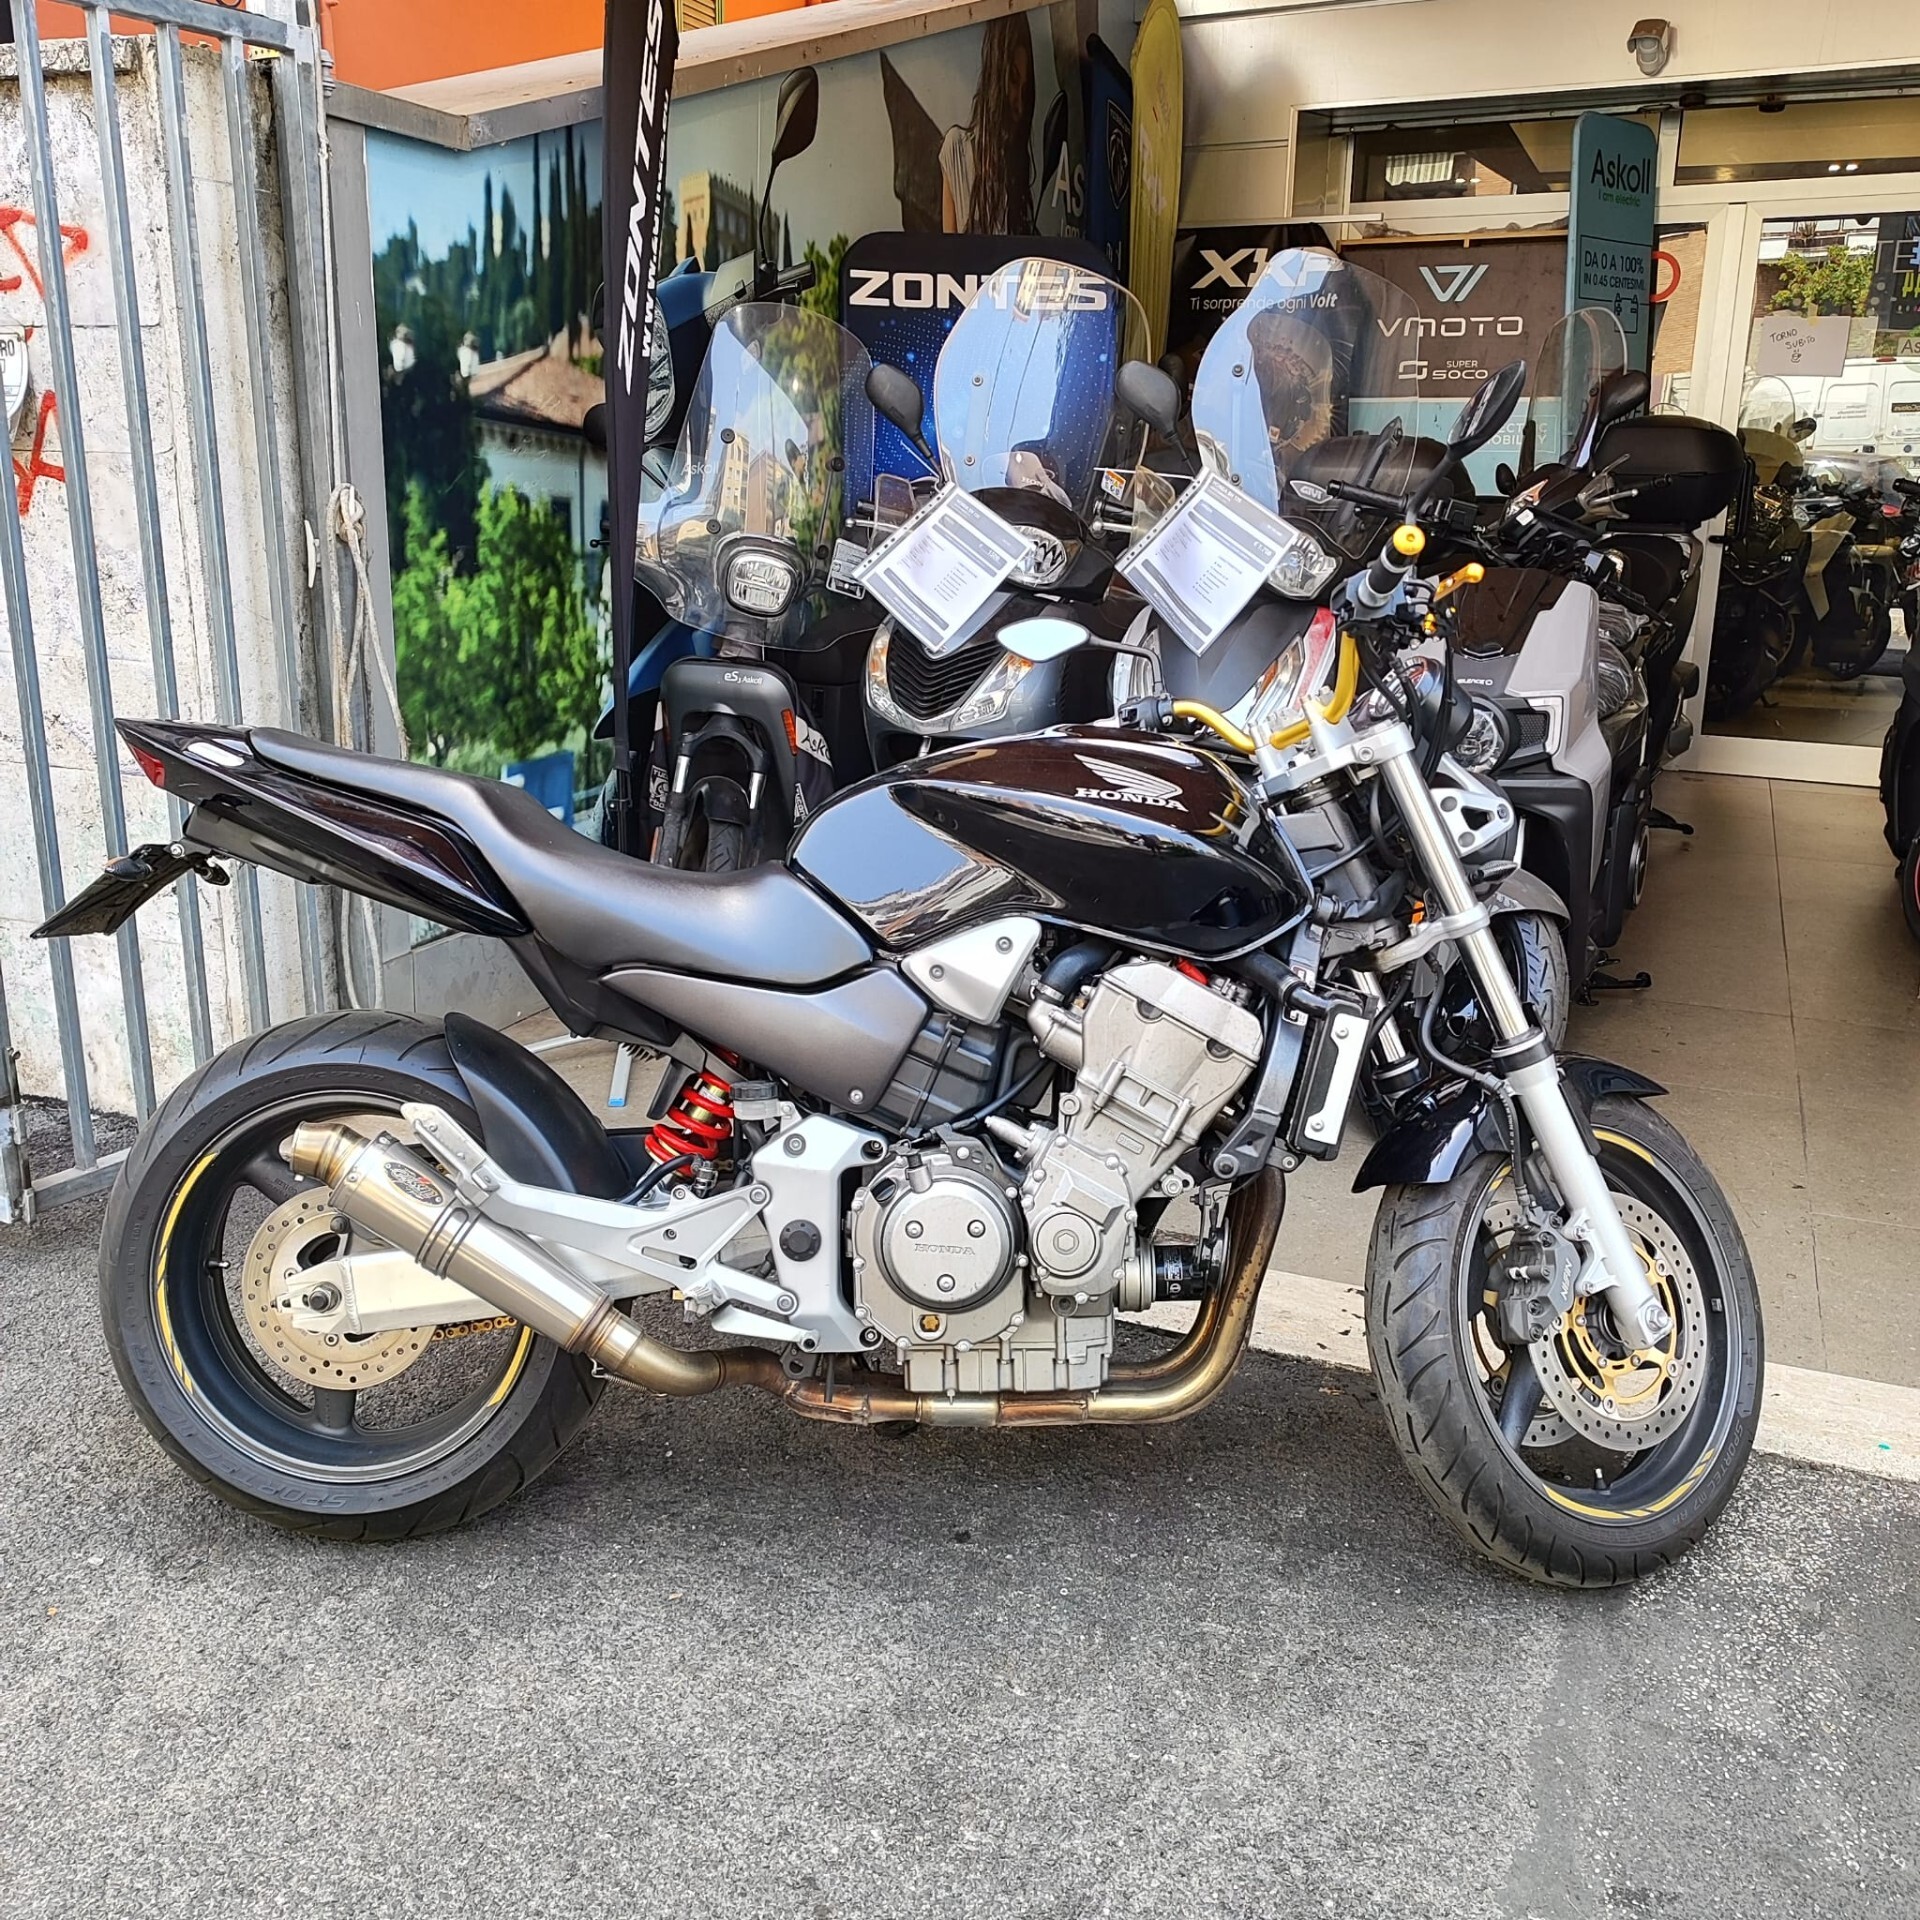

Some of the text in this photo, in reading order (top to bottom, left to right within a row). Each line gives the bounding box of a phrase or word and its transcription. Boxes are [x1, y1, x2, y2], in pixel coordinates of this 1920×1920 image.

[1591, 149, 1651, 195] Askoll
[618, 0, 663, 396] ZONTES
[1615, 193, 1641, 207] electric
[1585, 250, 1644, 274] DA 0 A 100%
[1584, 273, 1592, 285] IN
[850, 269, 1107, 311] ZONTES
[1190, 292, 1339, 313] Ti sorprende ogni Volt
[1377, 315, 1524, 338] VMOTO
[1769, 328, 1798, 343] TORNO
[1446, 360, 1478, 369] SUPER
[1432, 369, 1489, 380] SOCO
[680, 461, 720, 476] Askoll
[1300, 485, 1322, 500] GIVI
[1074, 787, 1189, 813] HONDA
[914, 1243, 976, 1256] HONDA
